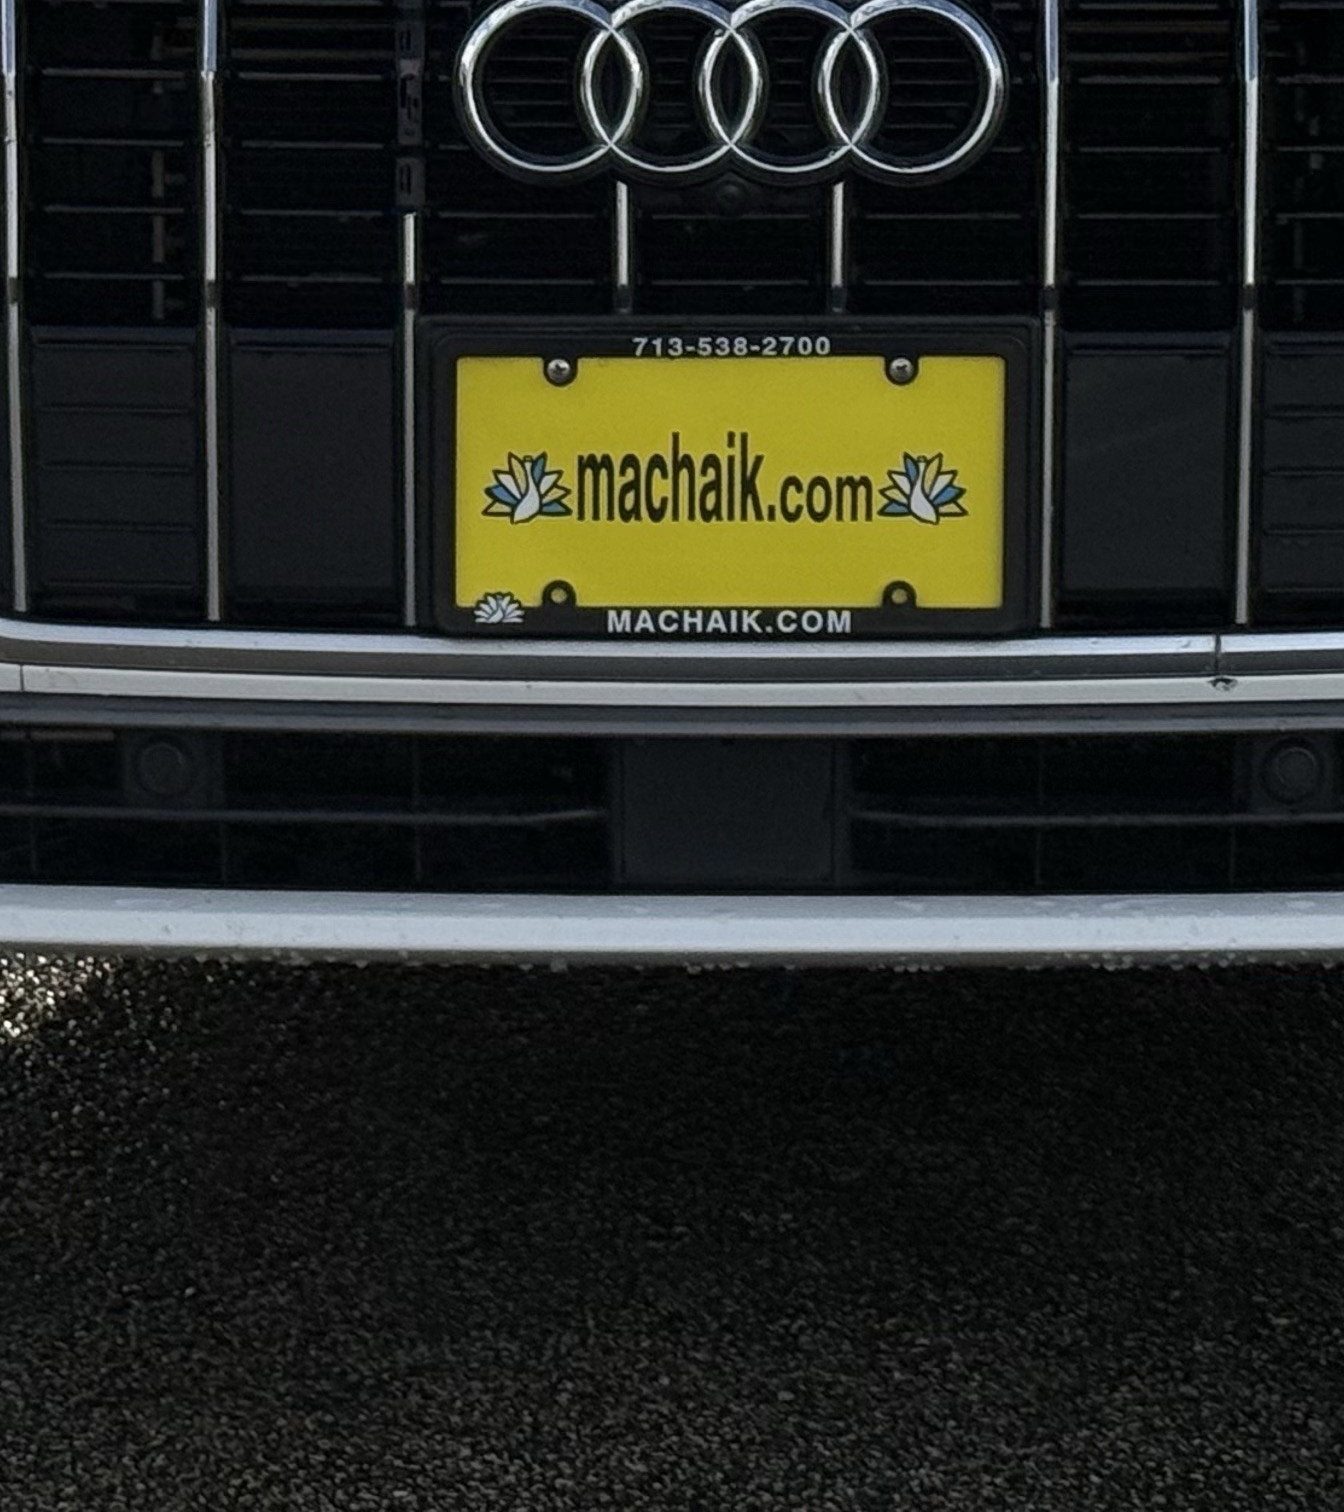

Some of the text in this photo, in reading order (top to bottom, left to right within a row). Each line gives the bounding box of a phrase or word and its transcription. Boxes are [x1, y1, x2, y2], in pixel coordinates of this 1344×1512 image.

[632, 337, 831, 356] 713-538-2700
[577, 431, 873, 523] machaik.com
[607, 609, 852, 634] MACHAIK.COM
